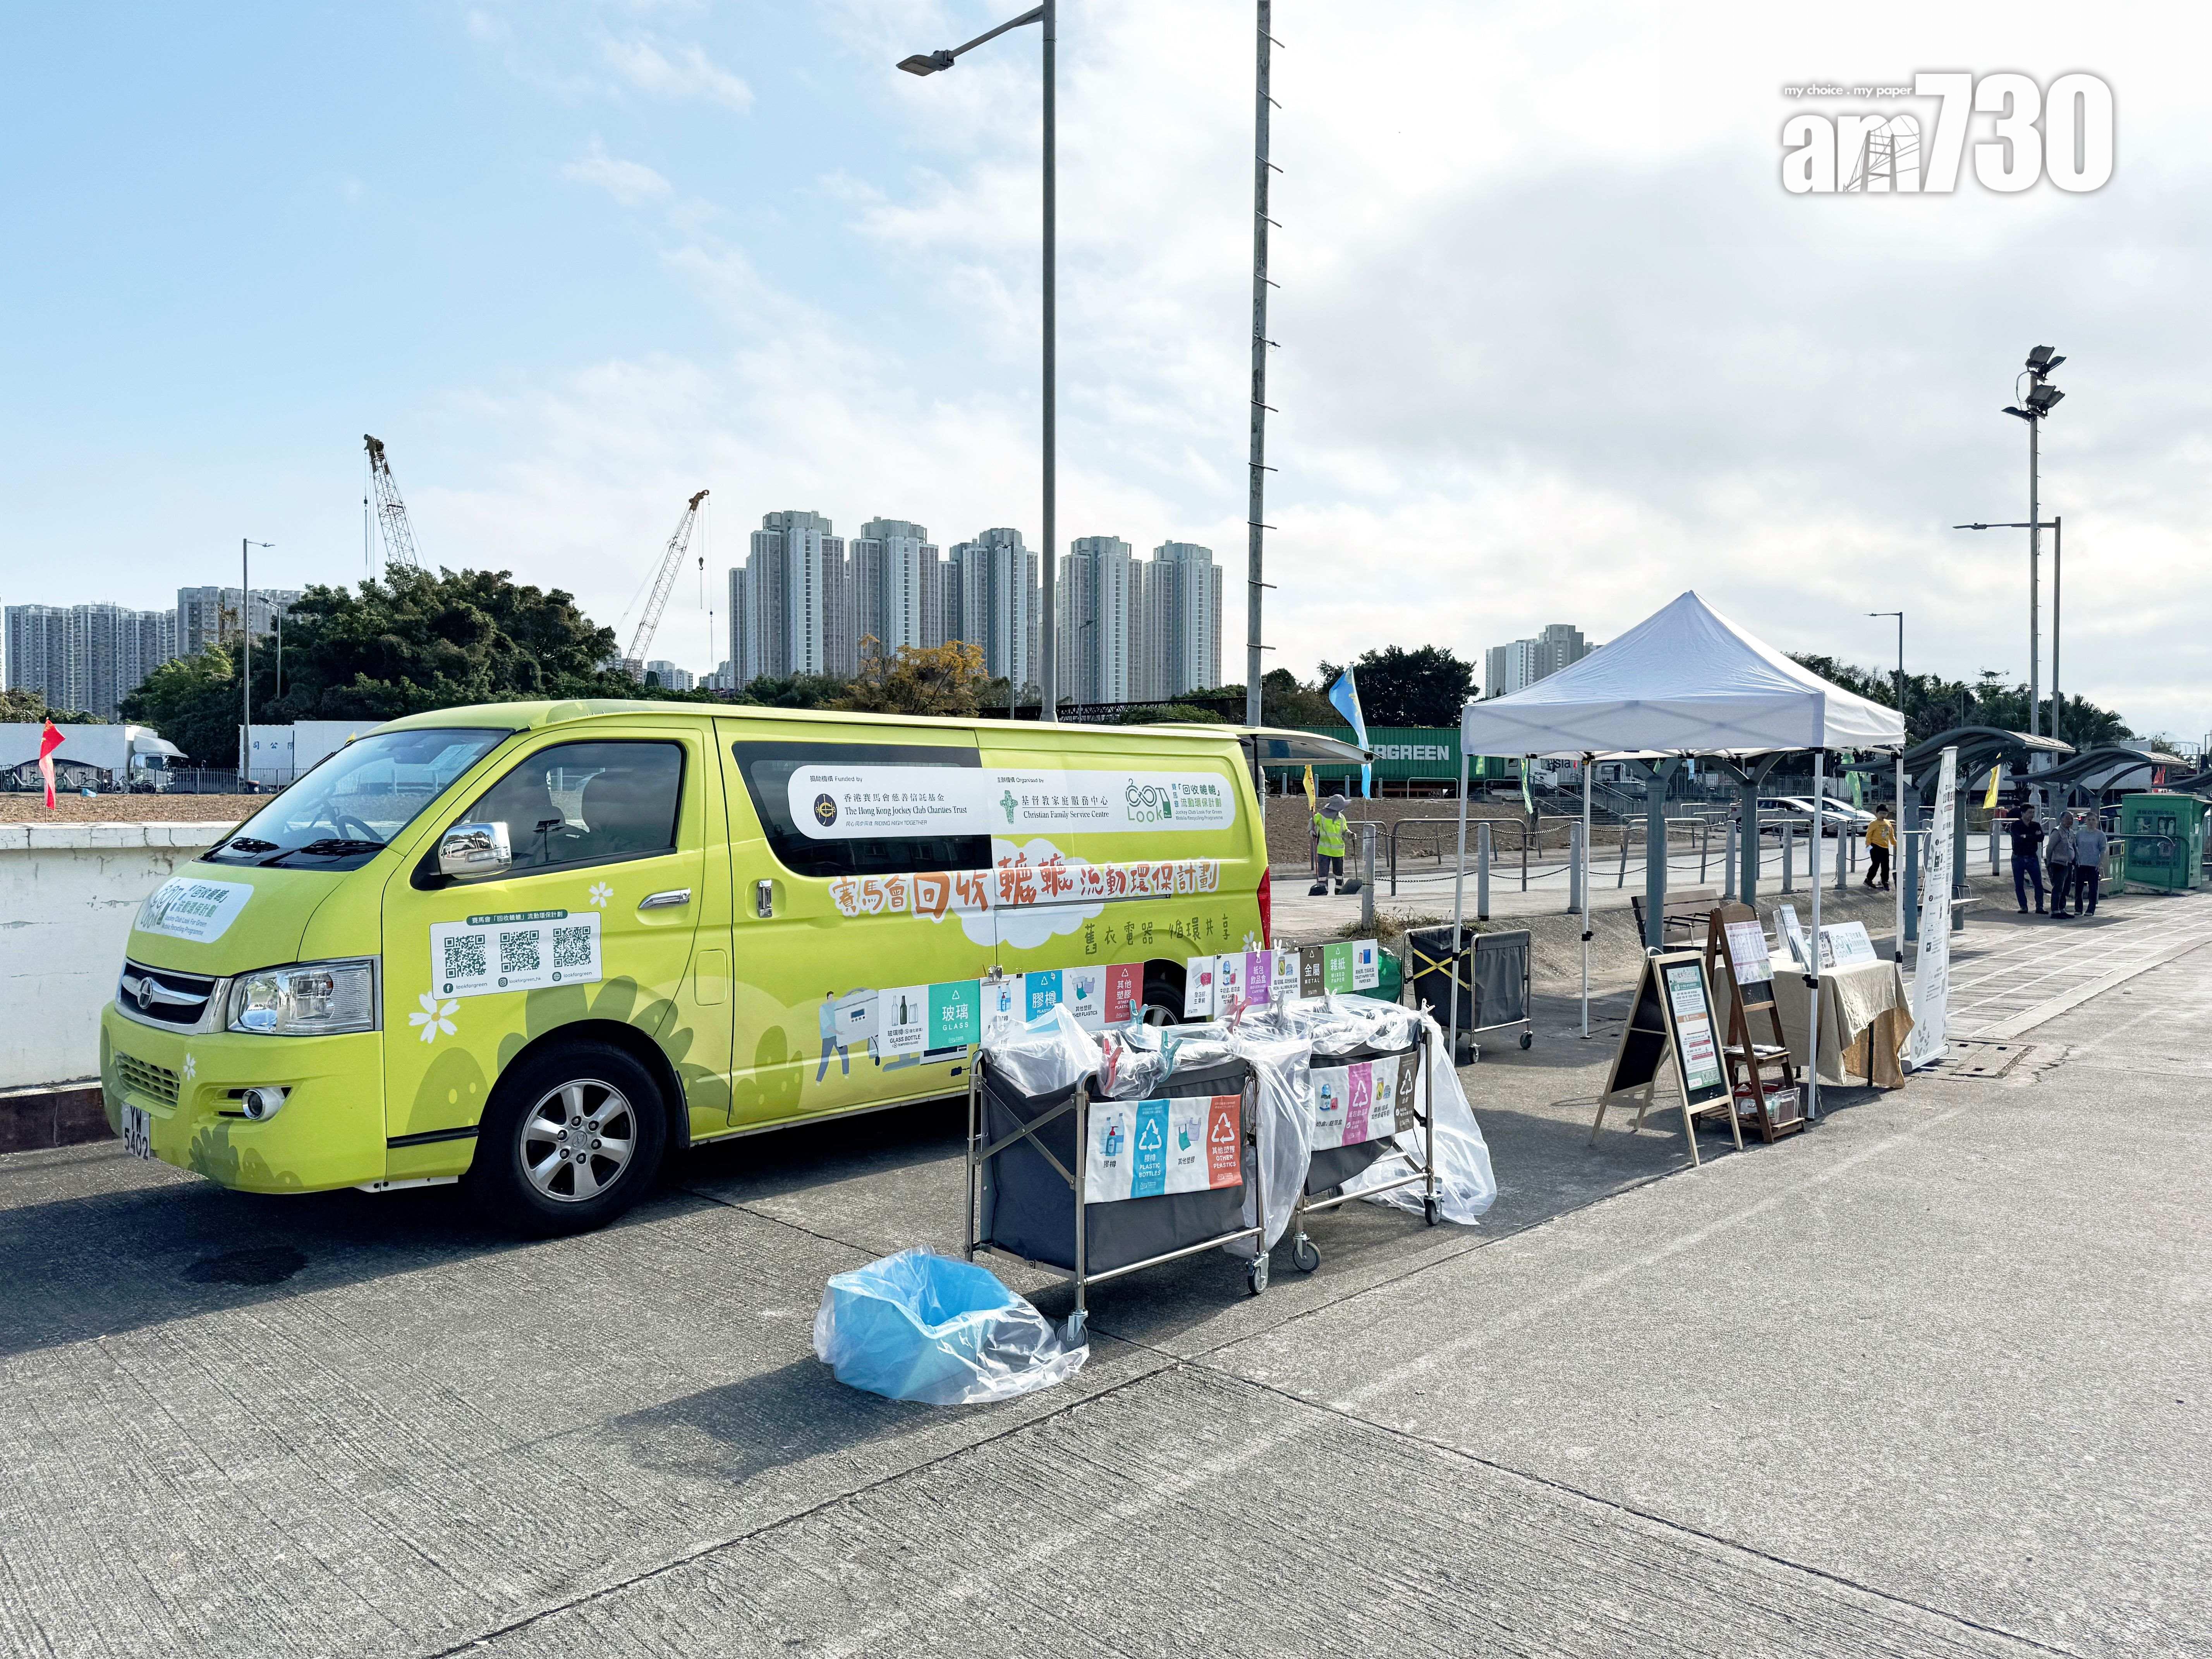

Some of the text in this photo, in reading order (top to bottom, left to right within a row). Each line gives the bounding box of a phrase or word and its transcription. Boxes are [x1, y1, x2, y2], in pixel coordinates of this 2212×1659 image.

[1357, 744, 1449, 760] RGREEN
[844, 793, 945, 802] 香港賽馬會慈善信託基金
[1022, 795, 1108, 806] 基督教家庭服務中心
[1180, 798, 1222, 807] 流動環保計劃
[845, 807, 857, 815] The
[859, 806, 874, 816] Hong
[876, 806, 891, 816] Kong
[892, 806, 911, 816] Jockey
[927, 805, 951, 814] Charities
[953, 805, 967, 814] Trust
[1051, 811, 1069, 819] Family
[1127, 805, 1163, 823] Look
[1330, 957, 1345, 971] 雜紙
[1253, 965, 1264, 975] 紙包
[1304, 963, 1320, 977] 金屬
[1117, 979, 1132, 989] 其他
[1250, 975, 1266, 985] 飲品盒
[1032, 990, 1056, 1008] 膠樽
[1116, 989, 1131, 1000] 塑膠
[942, 1003, 969, 1022] 玻璃
[943, 1022, 969, 1030] GLASS
[130, 1106, 141, 1133] YW
[125, 1127, 148, 1160] 5402
[1212, 1145, 1235, 1155] 其他塑膠
[1144, 1153, 1156, 1162] 膠樽
[1178, 1156, 1195, 1166] 其他塑膠
